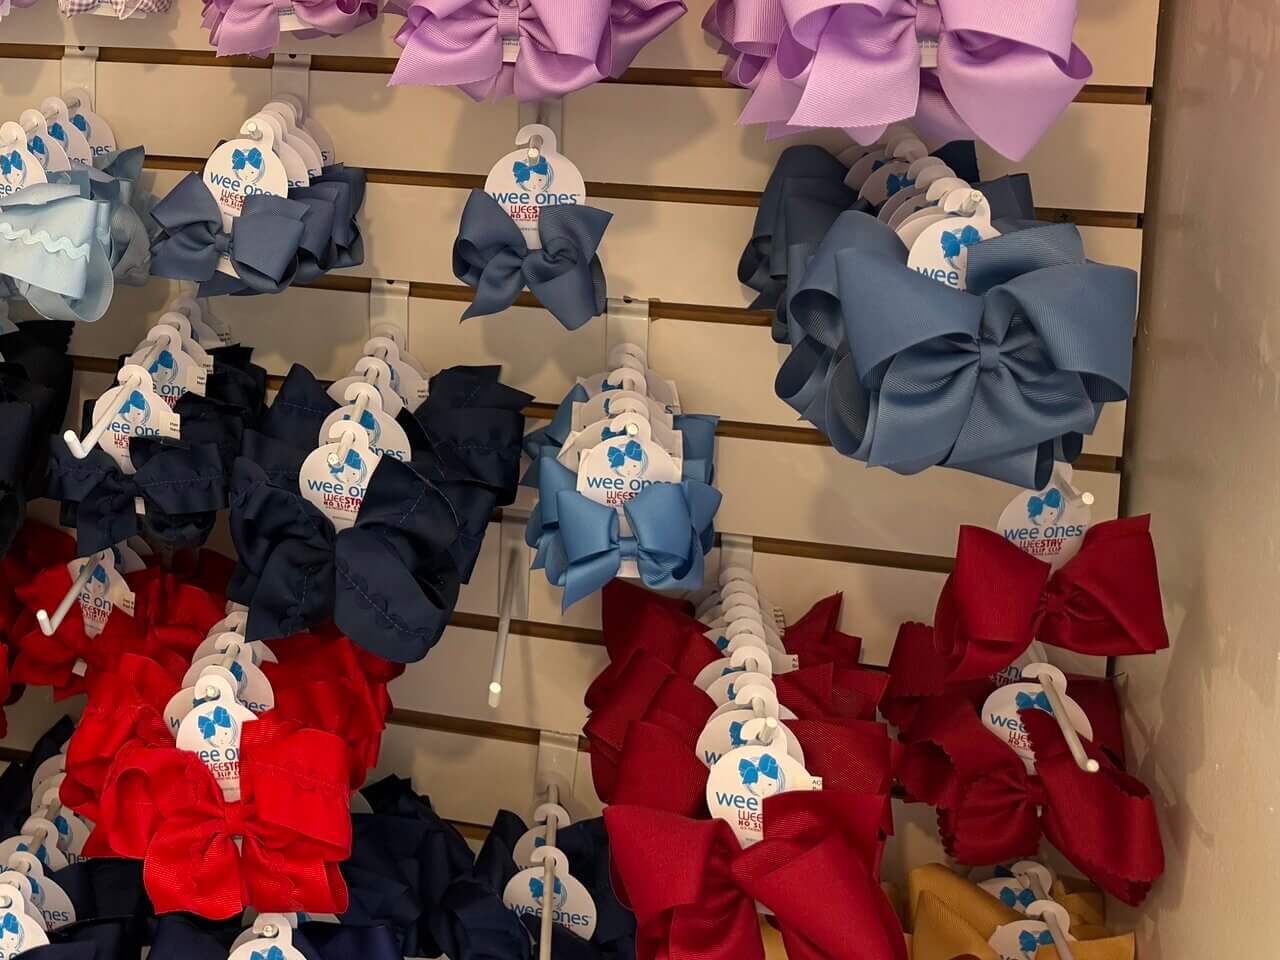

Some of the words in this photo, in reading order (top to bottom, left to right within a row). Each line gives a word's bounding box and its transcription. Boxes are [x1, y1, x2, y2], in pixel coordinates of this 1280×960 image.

[211, 171, 240, 193] wee
[493, 193, 529, 204] wee
[535, 193, 577, 204] ones
[308, 479, 344, 495] wee
[587, 476, 624, 490] wee
[1004, 527, 1037, 540] wee
[1044, 524, 1083, 539] ones
[716, 792, 758, 811] wee
